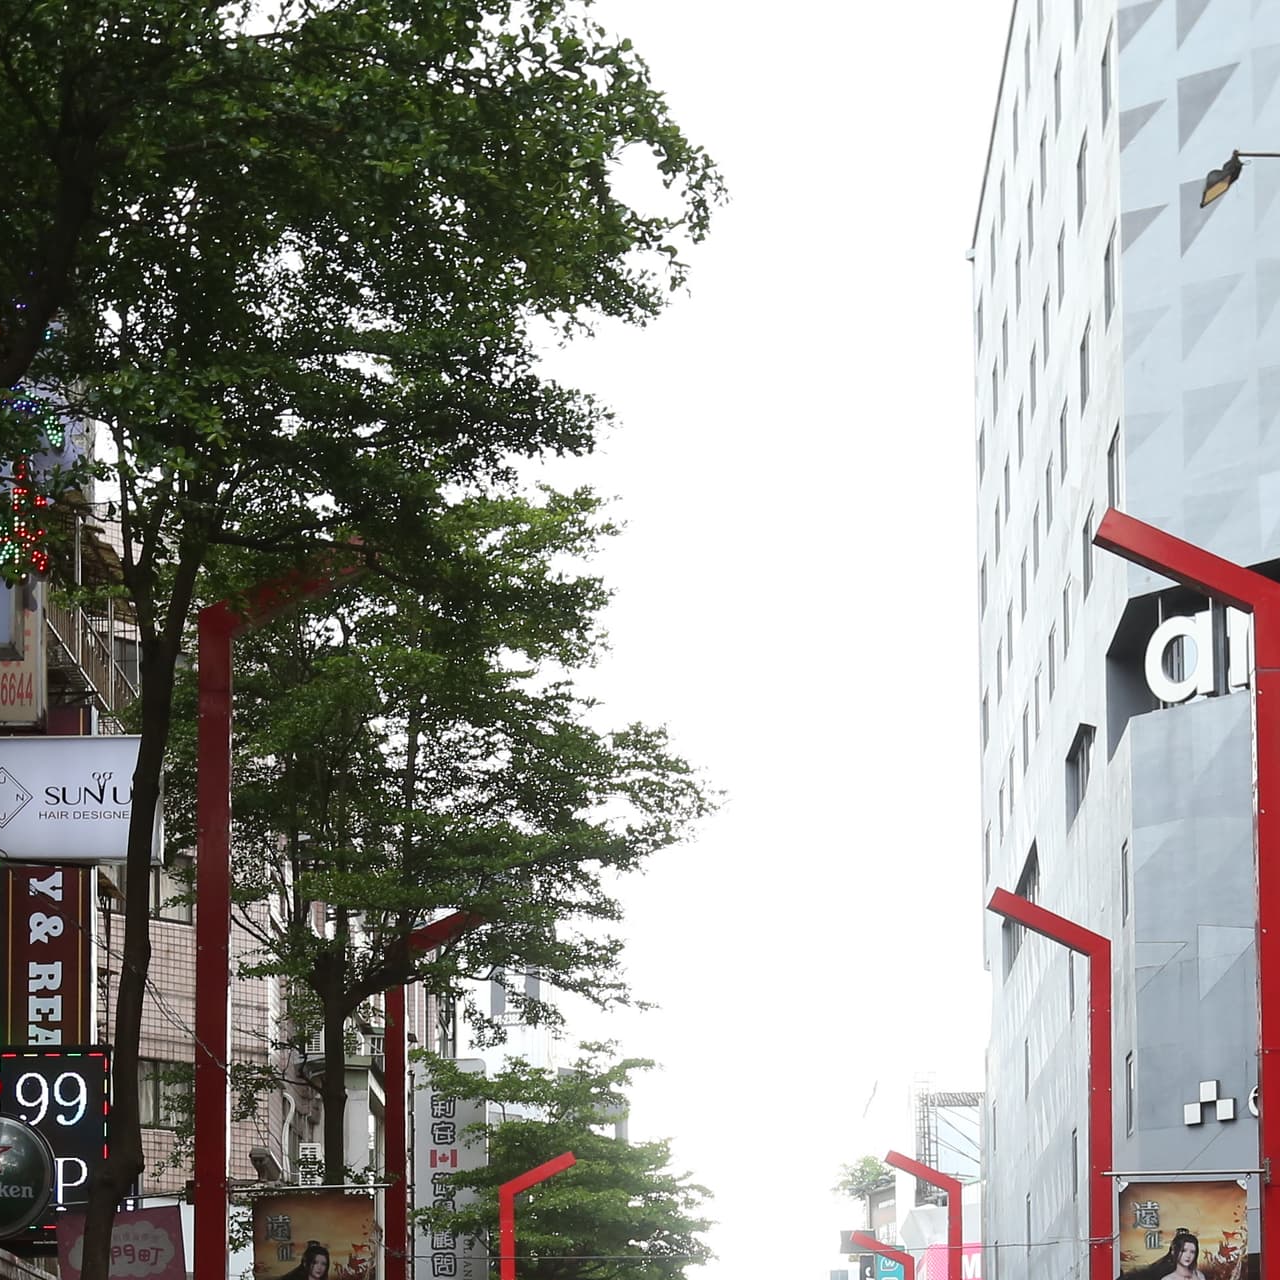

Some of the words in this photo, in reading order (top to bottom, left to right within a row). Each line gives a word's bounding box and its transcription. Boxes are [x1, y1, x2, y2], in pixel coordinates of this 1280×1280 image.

[38, 811, 68, 820] HAIR
[15, 1071, 87, 1126] 99
[1133, 1200, 1163, 1250] 遠征
